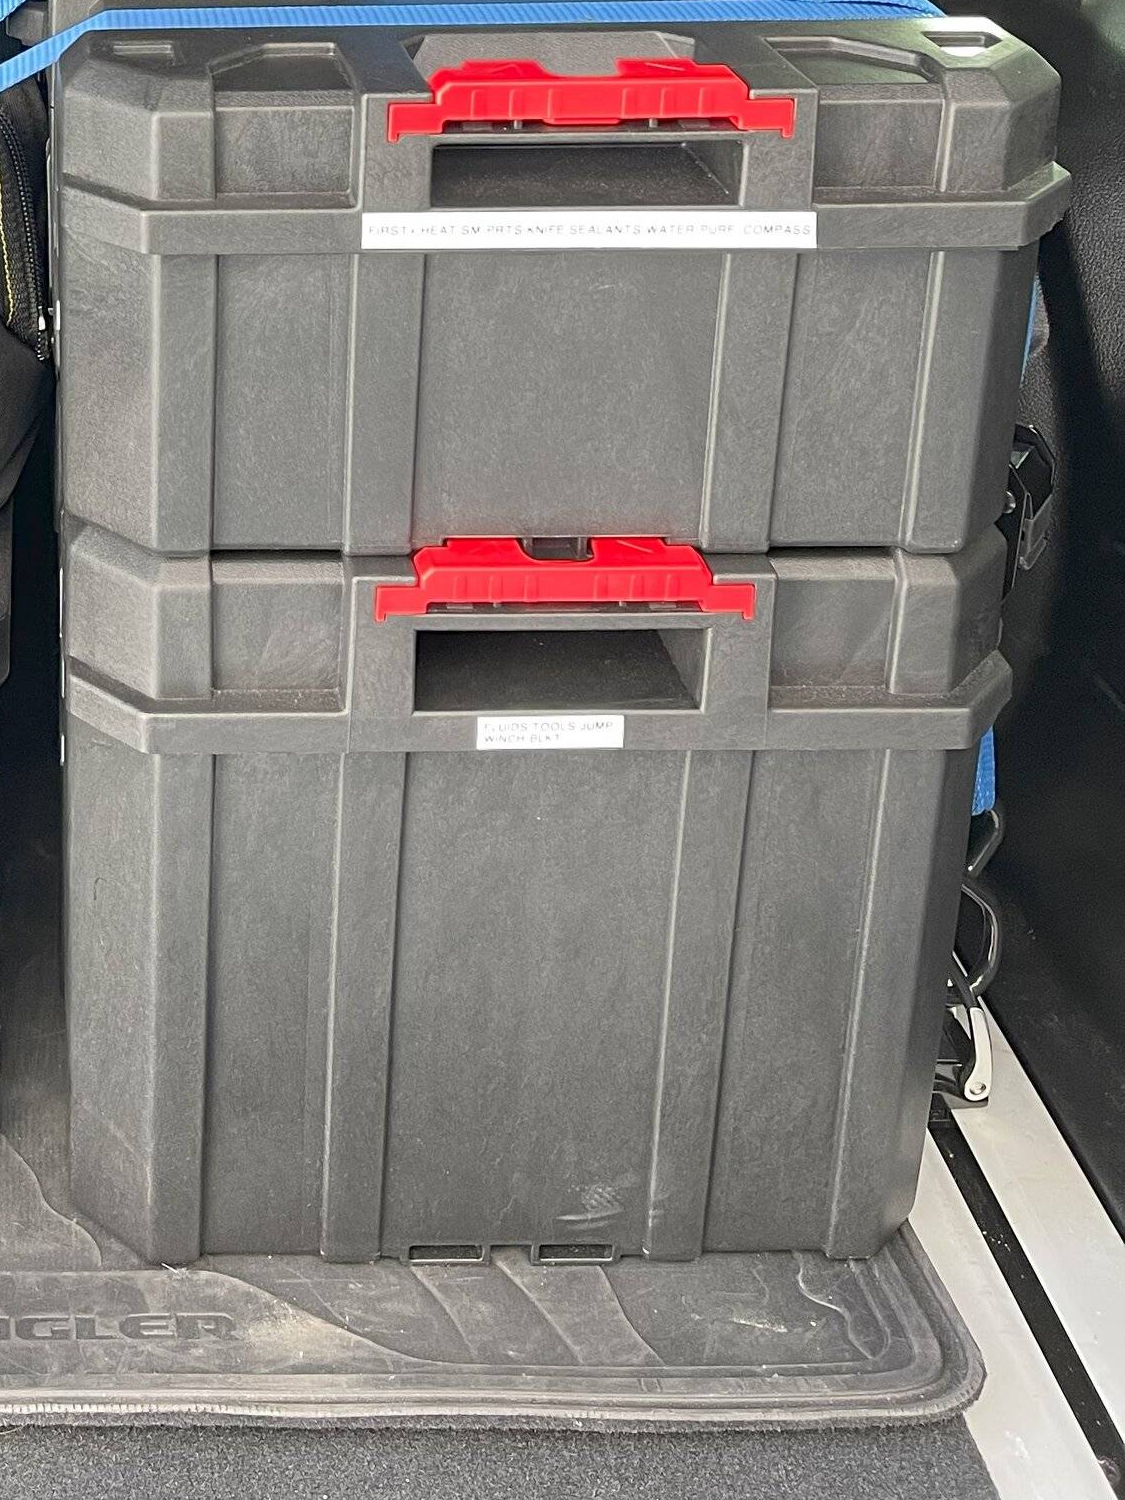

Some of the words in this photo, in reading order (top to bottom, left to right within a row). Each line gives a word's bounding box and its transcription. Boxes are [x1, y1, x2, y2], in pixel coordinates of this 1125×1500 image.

[569, 224, 641, 235] SEALANTS
[647, 224, 695, 235] WATER
[743, 224, 812, 235] COMPASS
[533, 721, 575, 732] TOOLS
[580, 721, 614, 731] JUMP
